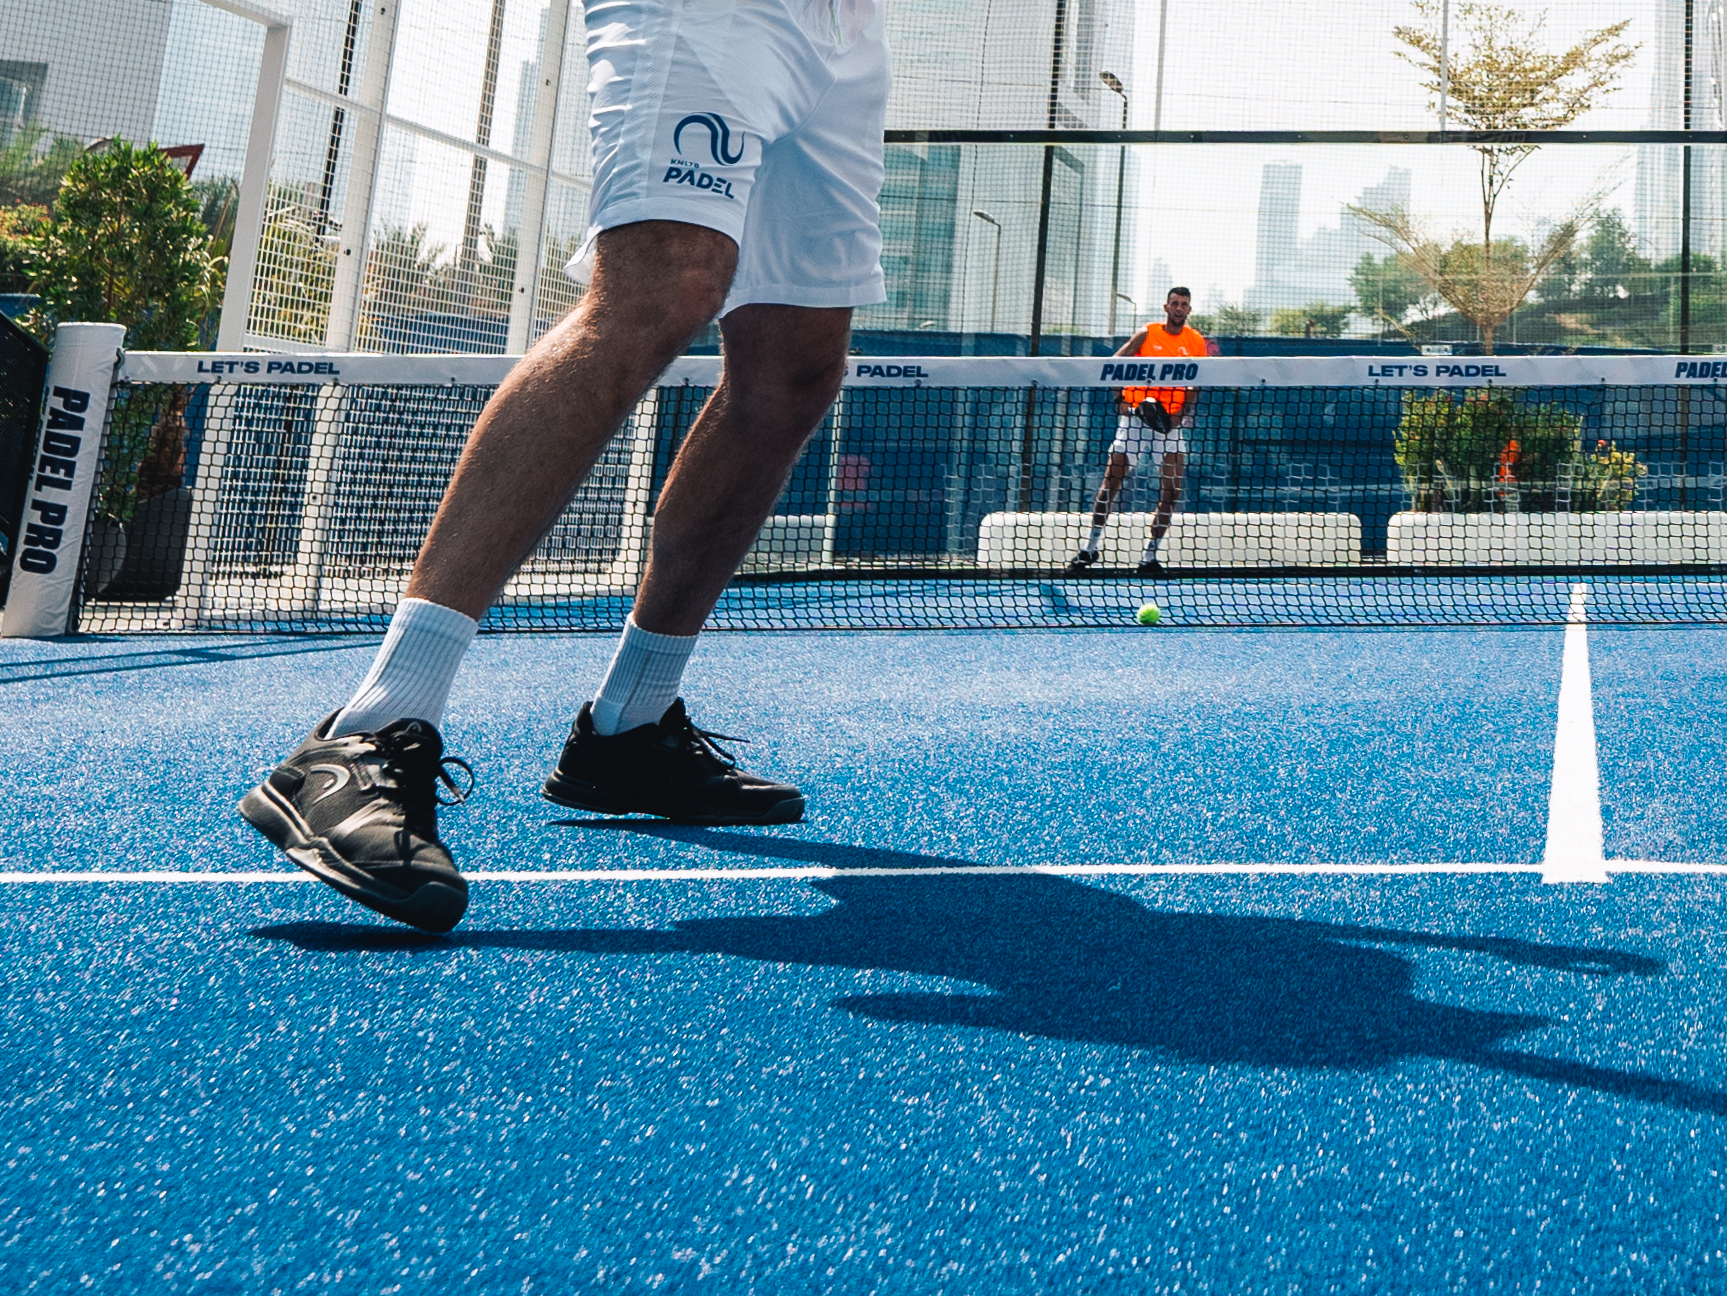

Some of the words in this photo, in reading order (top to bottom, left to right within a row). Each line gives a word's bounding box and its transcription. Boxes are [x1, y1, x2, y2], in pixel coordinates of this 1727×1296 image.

[662, 166, 735, 200] PADEL
[197, 360, 261, 375] LET'S
[266, 361, 340, 375] PADEL
[856, 364, 929, 378] PADEL
[1099, 363, 1156, 381] PADEL
[1159, 363, 1199, 381] PRO
[1367, 364, 1429, 378] LET'S
[1435, 364, 1507, 378] PADEL
[34, 385, 91, 492] PADEL
[20, 498, 69, 575] PRO
